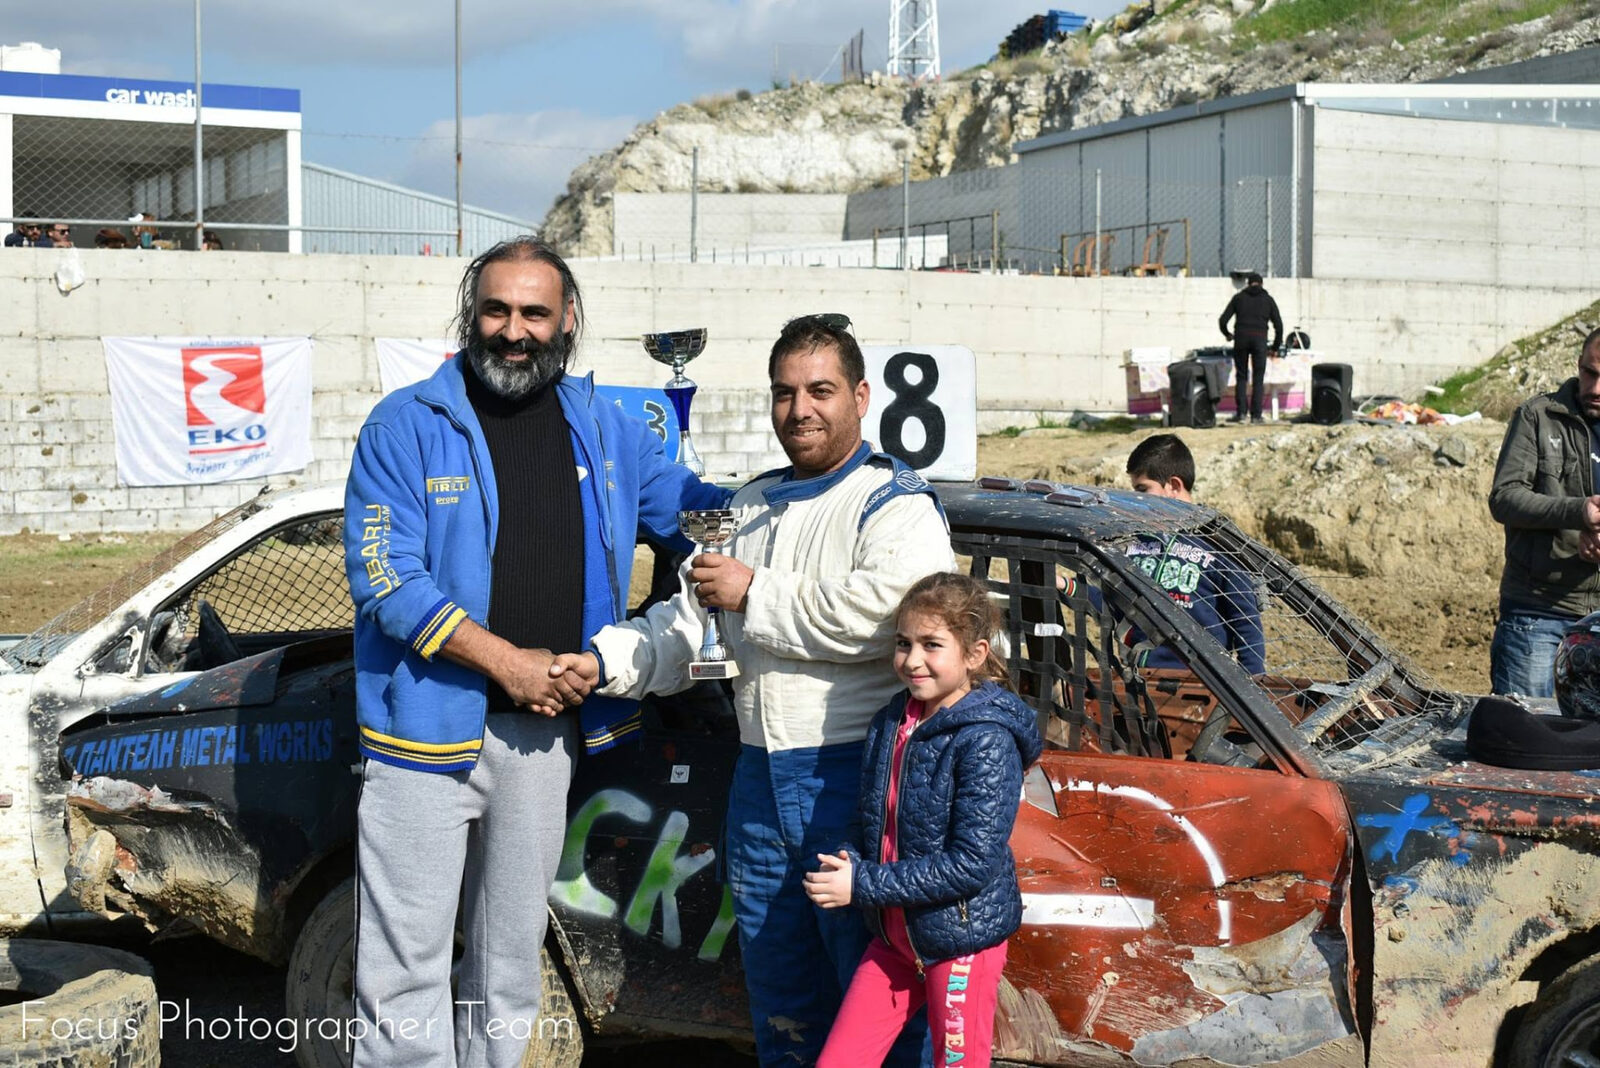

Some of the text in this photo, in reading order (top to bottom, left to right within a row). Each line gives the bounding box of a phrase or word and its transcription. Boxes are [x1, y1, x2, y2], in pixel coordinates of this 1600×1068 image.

[105, 88, 197, 107] car wash
[188, 424, 266, 446] EKO
[879, 351, 946, 470] 8
[361, 504, 393, 598] UBARU
[179, 725, 250, 768] METAL
[257, 718, 334, 763] WORKS
[945, 1016, 965, 1068] TEA
